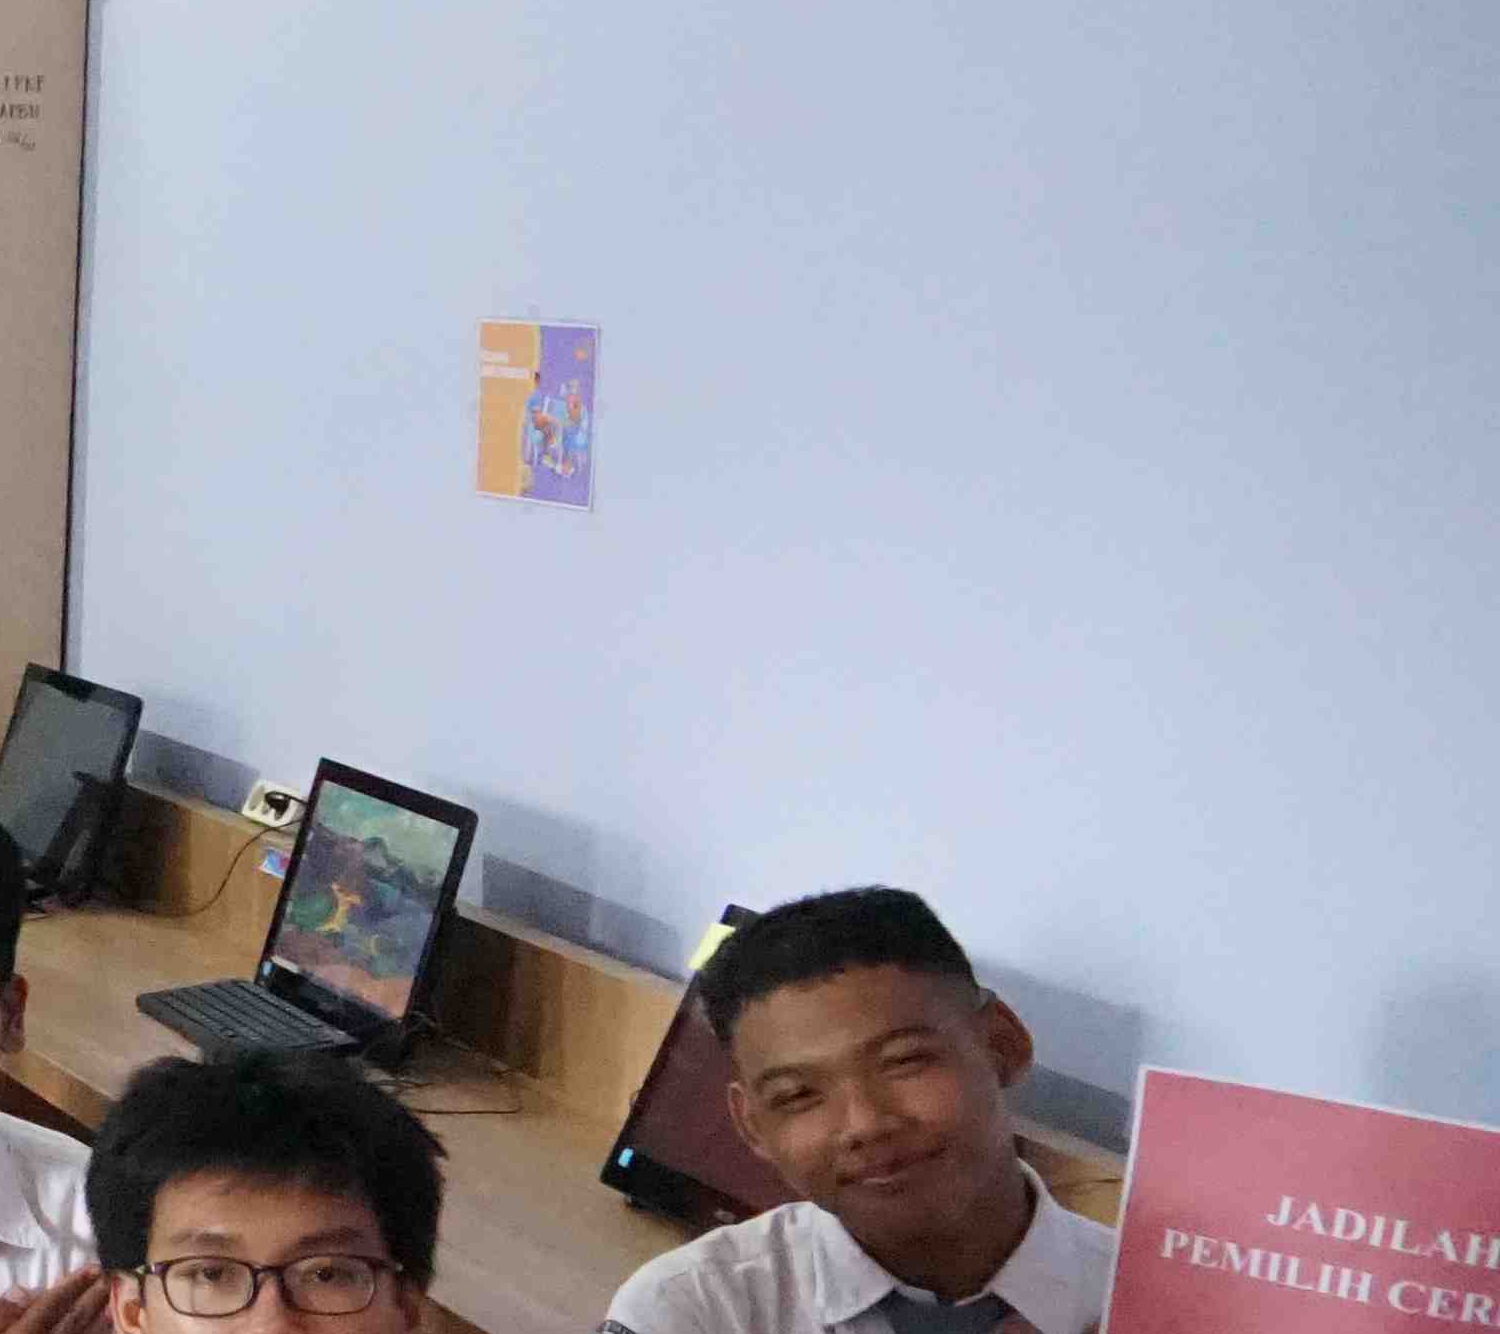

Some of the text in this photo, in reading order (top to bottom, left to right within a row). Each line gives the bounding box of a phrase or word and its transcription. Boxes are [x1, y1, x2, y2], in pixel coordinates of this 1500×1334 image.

[1266, 1194, 1500, 1270] JADILAH
[1160, 1227, 1500, 1330] PEMILIH CER
